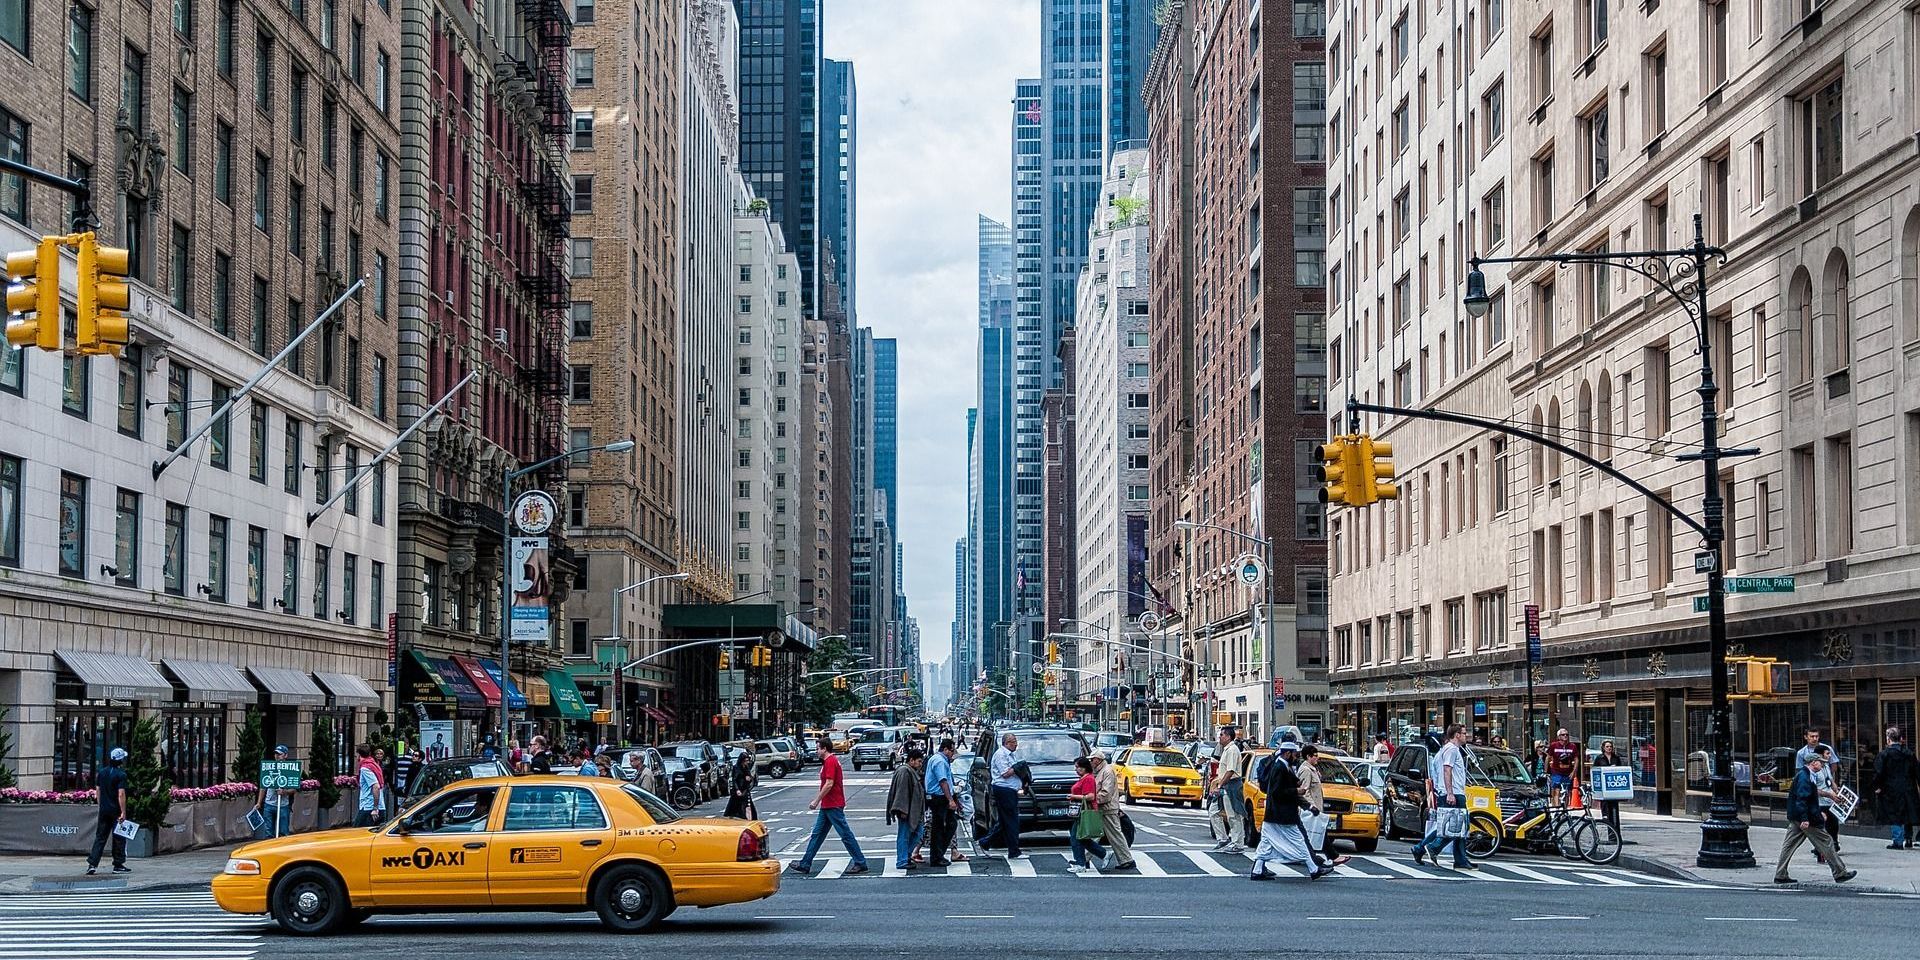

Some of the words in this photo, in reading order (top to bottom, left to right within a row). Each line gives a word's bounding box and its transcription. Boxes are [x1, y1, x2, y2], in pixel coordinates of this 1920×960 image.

[1737, 579, 1771, 588] CENTRAL
[1773, 578, 1793, 587] PARK
[261, 762, 276, 771] BIKE
[276, 762, 300, 771] RENTAL
[1607, 780, 1629, 788] TODAY
[41, 825, 79, 834] MARKET
[382, 856, 412, 867] NYC
[415, 849, 465, 868] TAXI
